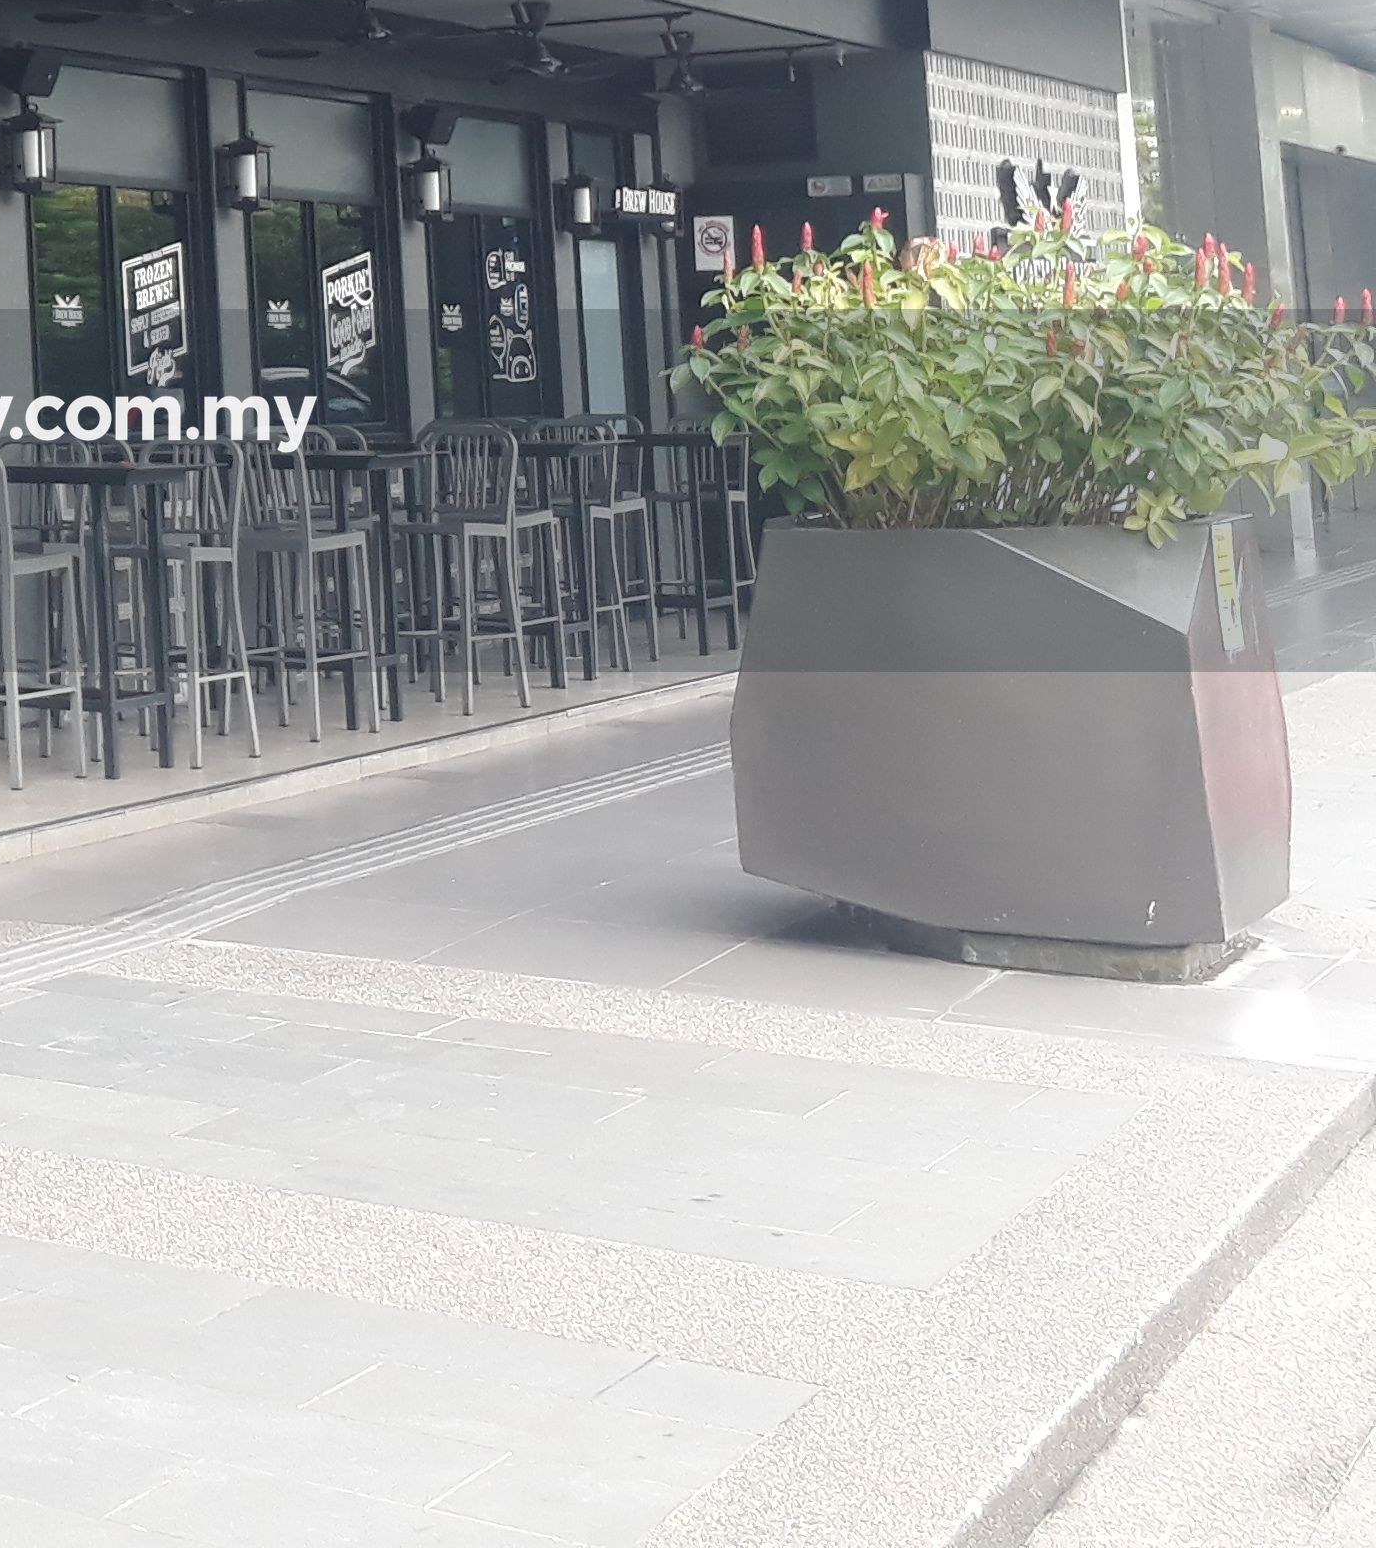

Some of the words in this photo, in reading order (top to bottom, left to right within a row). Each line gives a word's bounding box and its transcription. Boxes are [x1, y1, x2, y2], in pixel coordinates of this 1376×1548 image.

[622, 187, 647, 213] BREW
[649, 188, 675, 215] HOUSE
[133, 257, 173, 289] FROZEN
